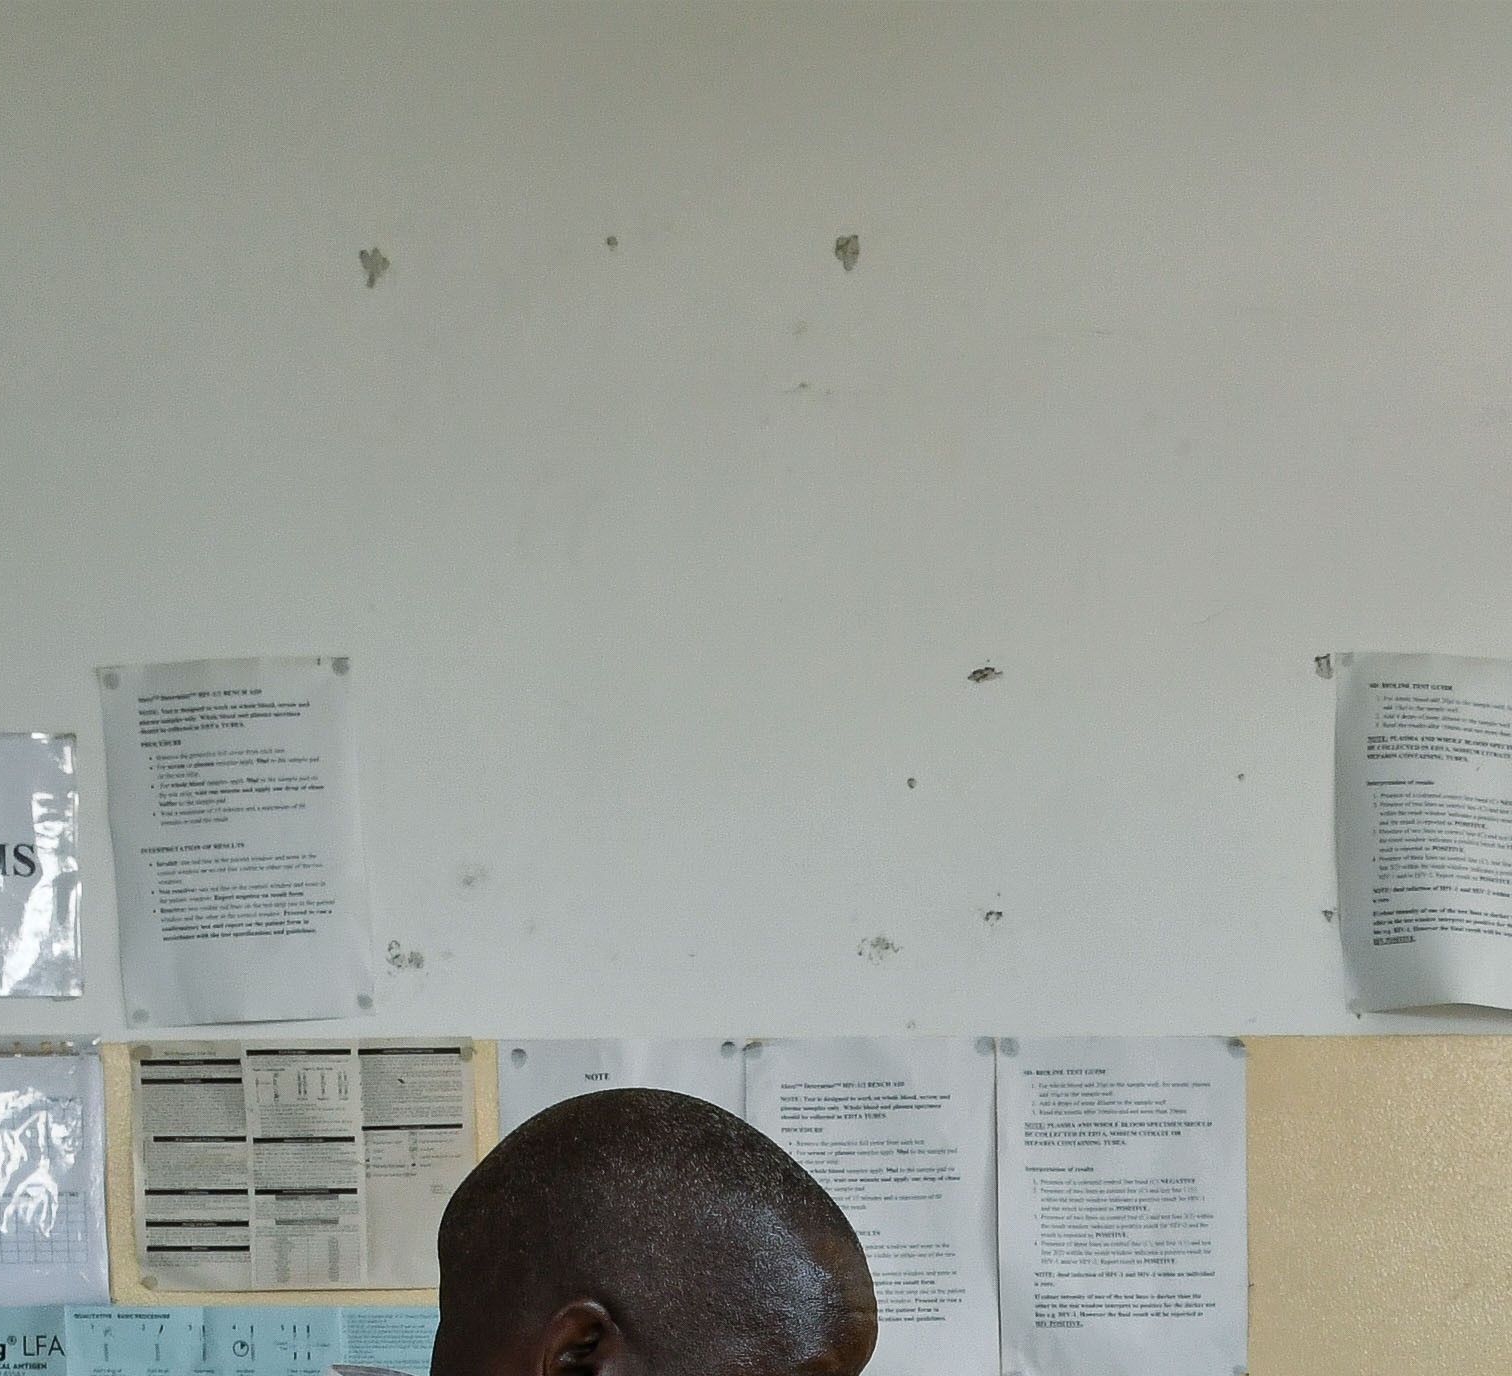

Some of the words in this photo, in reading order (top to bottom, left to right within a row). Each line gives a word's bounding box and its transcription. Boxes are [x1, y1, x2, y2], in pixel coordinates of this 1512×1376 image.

[584, 1072, 610, 1081] NOTE
[23, 1335, 65, 1356] LFA
[13, 1362, 47, 1370] ANTIGEN
